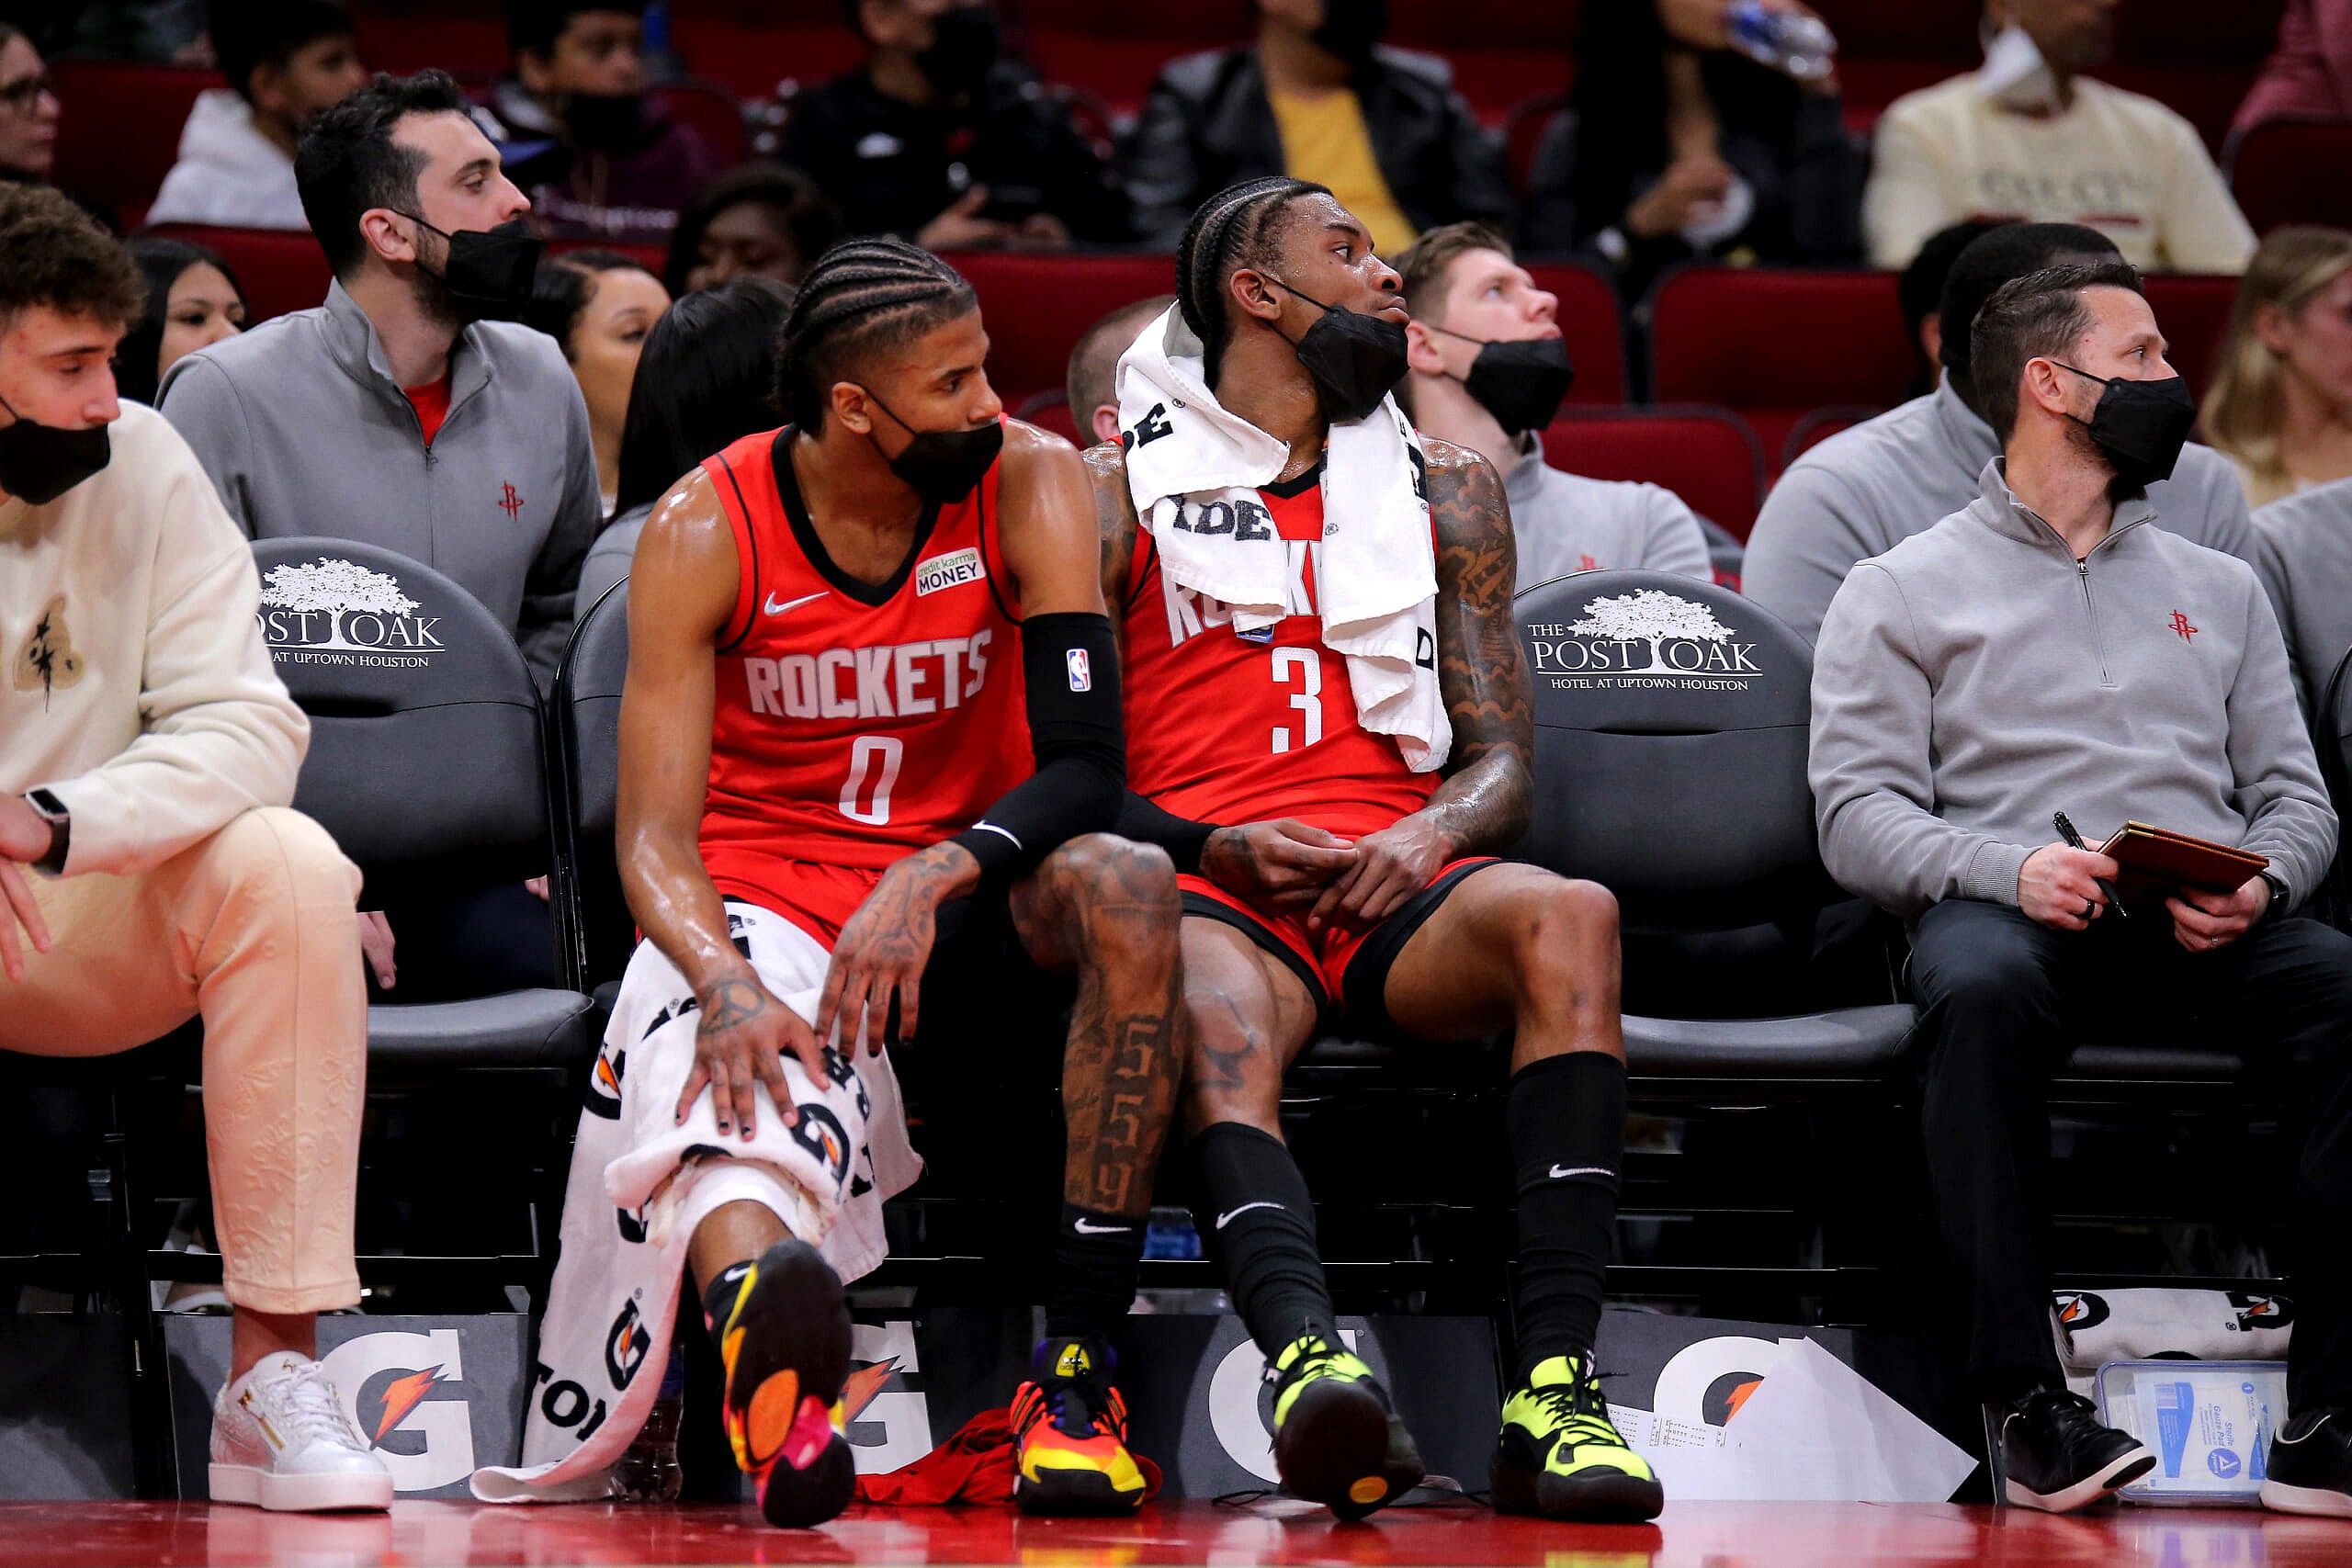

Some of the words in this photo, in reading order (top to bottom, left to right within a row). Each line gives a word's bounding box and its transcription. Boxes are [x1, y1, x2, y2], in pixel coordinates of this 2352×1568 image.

[943, 553, 976, 568] karma
[918, 562, 977, 594] MONEY
[350, 615, 446, 647] OAK
[1528, 625, 1565, 637] THE
[272, 651, 290, 663] AT
[294, 652, 355, 666] UPTOWN
[359, 655, 429, 669] HOUSTON
[1532, 640, 1638, 670] POST
[1668, 642, 1762, 671] OAK
[743, 627, 992, 719] ROCKETS
[1551, 678, 1593, 690] HOTEL
[1596, 678, 1612, 689] AT
[1617, 678, 1677, 690] UPTOWN
[1680, 680, 1749, 692] HOUSTON
[1272, 646, 1323, 755] 3
[838, 736, 903, 826] 0
[605, 1297, 651, 1392] G
[320, 1329, 476, 1492] G
